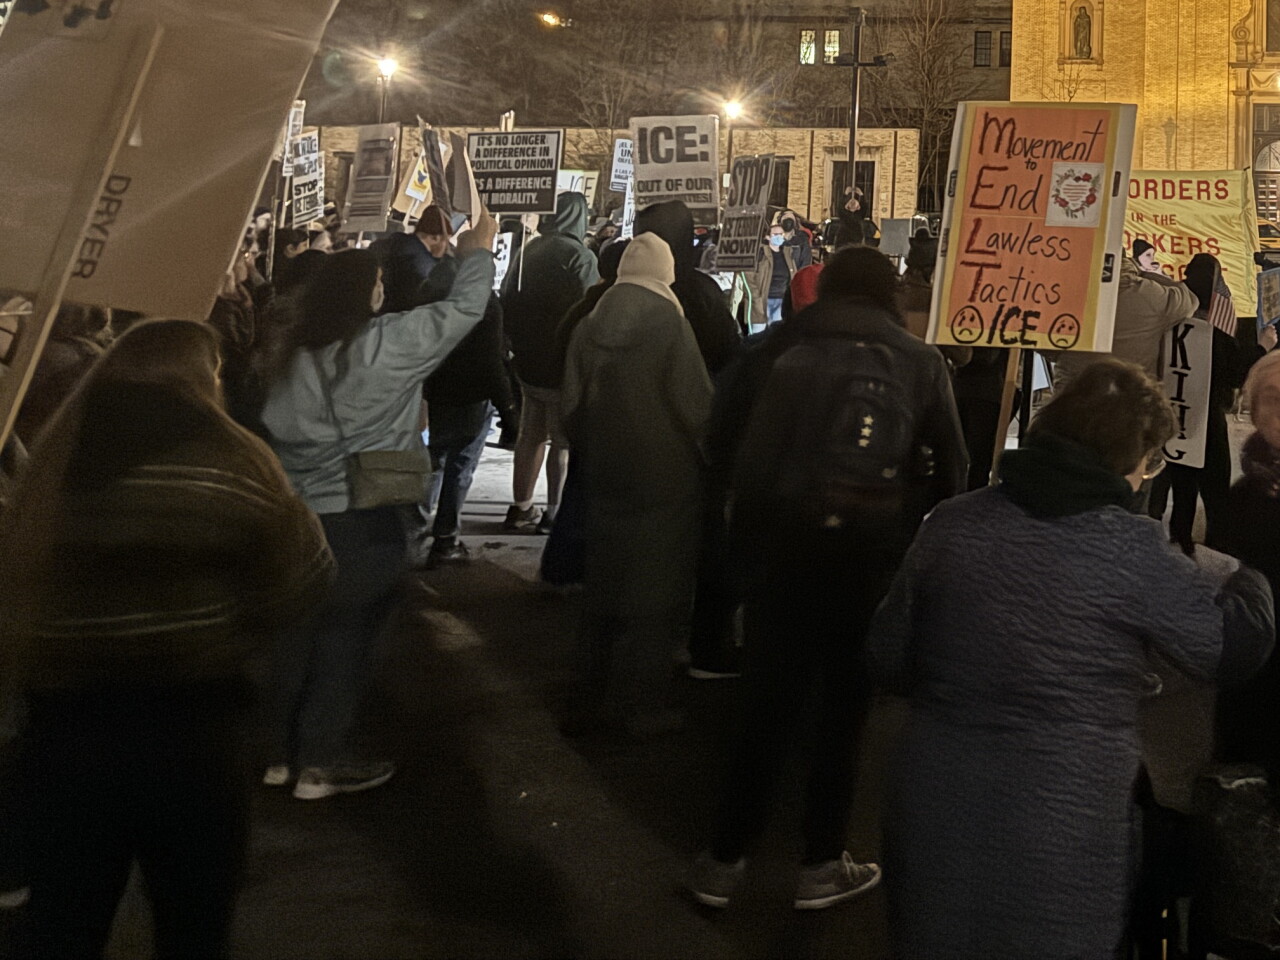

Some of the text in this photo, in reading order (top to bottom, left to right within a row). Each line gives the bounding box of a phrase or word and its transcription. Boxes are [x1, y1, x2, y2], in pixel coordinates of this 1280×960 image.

[477, 134, 546, 146] IT'S NO LONGER
[637, 126, 709, 164] ICE:
[978, 112, 1104, 161] Movement
[475, 146, 550, 158] A DIFFERENCE IN
[471, 158, 553, 170] POLITICAL OPINION
[1025, 157, 1037, 170] to
[294, 180, 318, 196] STOP
[486, 178, 493, 190] A
[495, 176, 552, 190] DIFFERENCE
[637, 180, 662, 193] OUT
[665, 179, 682, 191] OF
[685, 178, 713, 190] OUR
[728, 157, 771, 207] STOP
[969, 166, 1043, 214] End
[1129, 178, 1229, 201] ORDERS
[491, 192, 538, 204] MORALITY.
[71, 175, 132, 279] DRYER
[1131, 212, 1177, 226] IN THE
[965, 218, 1071, 261] Lawless
[960, 260, 1061, 304] Tactics
[986, 303, 1041, 346] ICE
